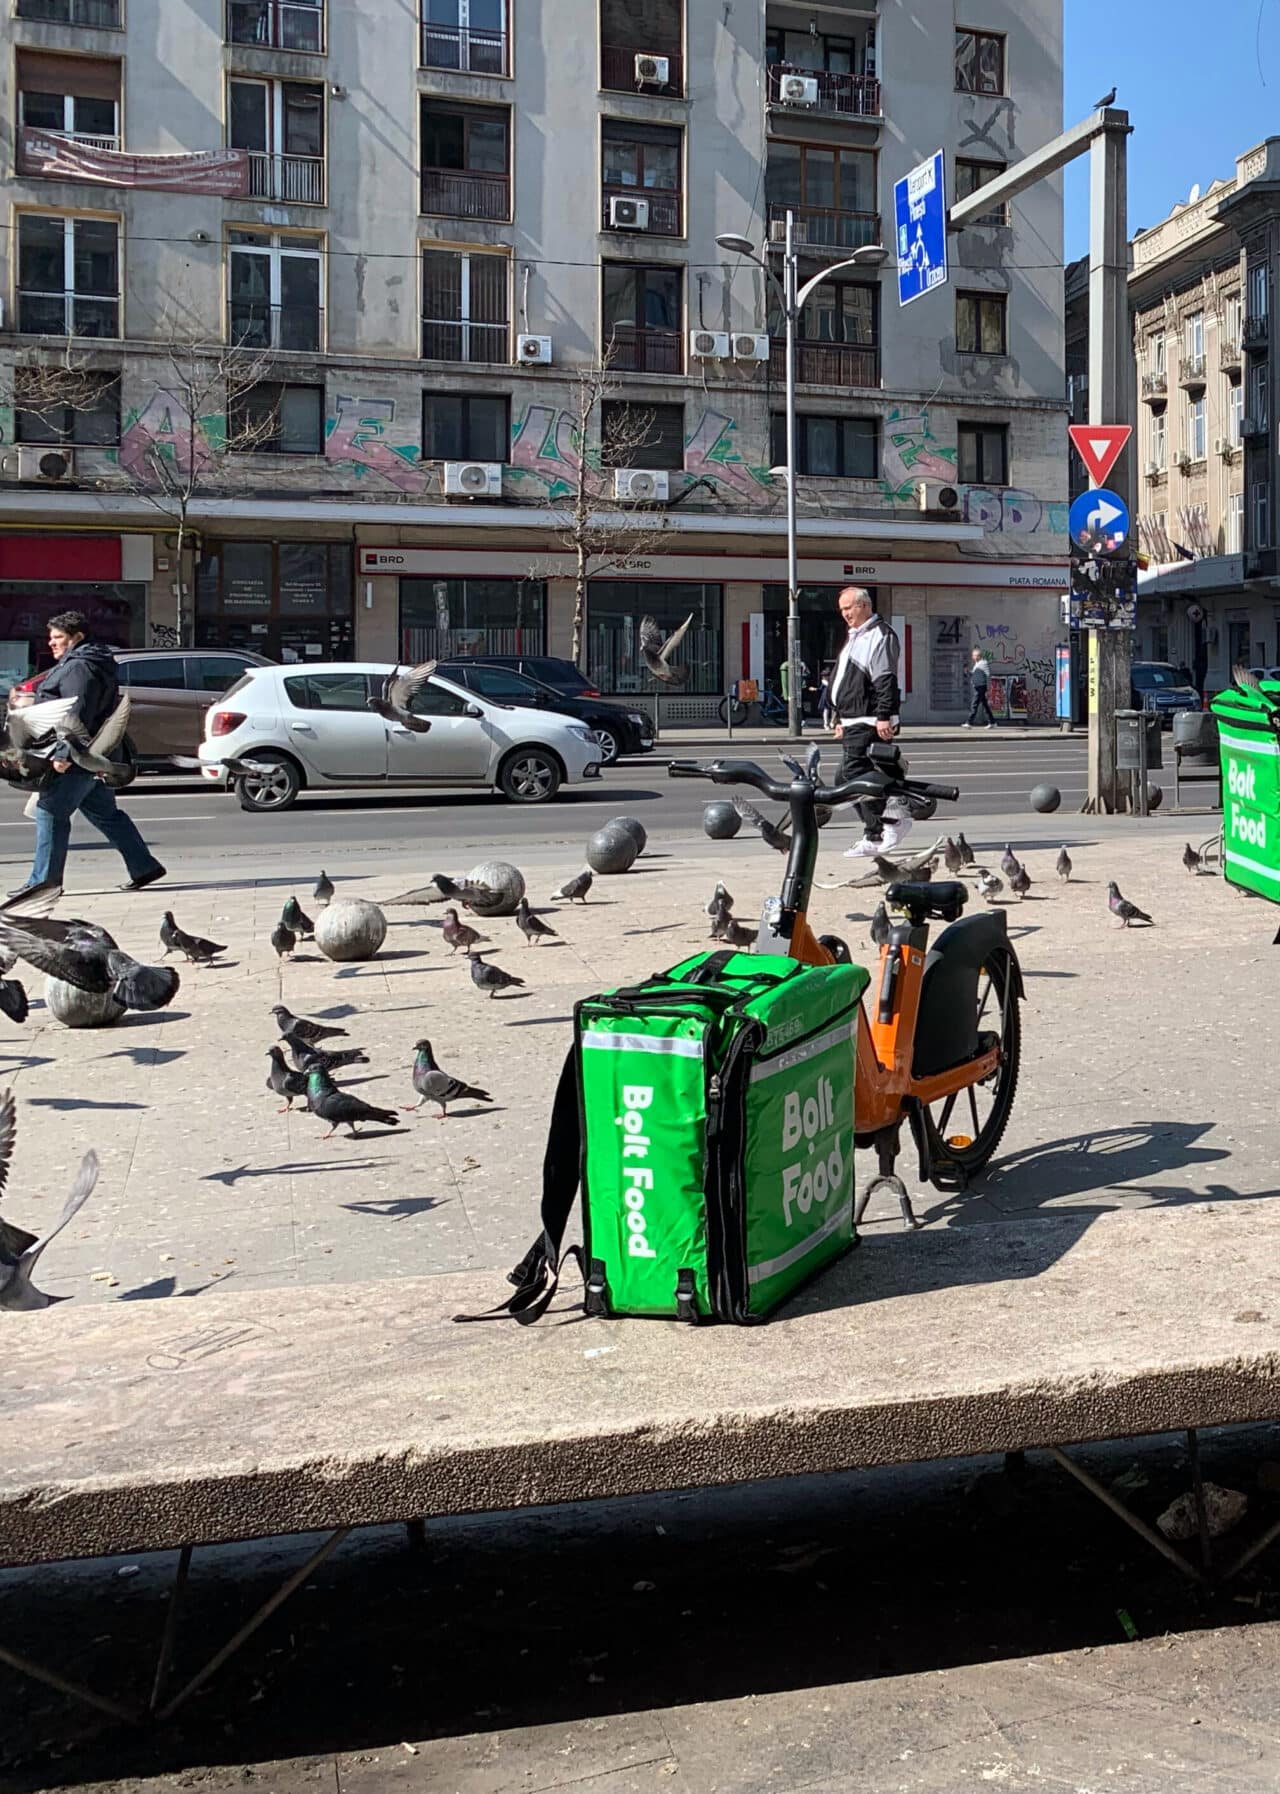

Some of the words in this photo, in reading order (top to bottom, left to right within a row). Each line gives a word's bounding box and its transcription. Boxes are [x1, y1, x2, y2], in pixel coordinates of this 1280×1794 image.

[379, 555, 405, 564] BRD
[855, 566, 876, 575] BRD
[1228, 758, 1256, 801] Bolt
[1231, 803, 1266, 849] Food
[616, 1085, 654, 1158] Bolt
[782, 1075, 834, 1153] Bolt
[782, 1133, 844, 1227] Food
[622, 1168, 656, 1258] Food
